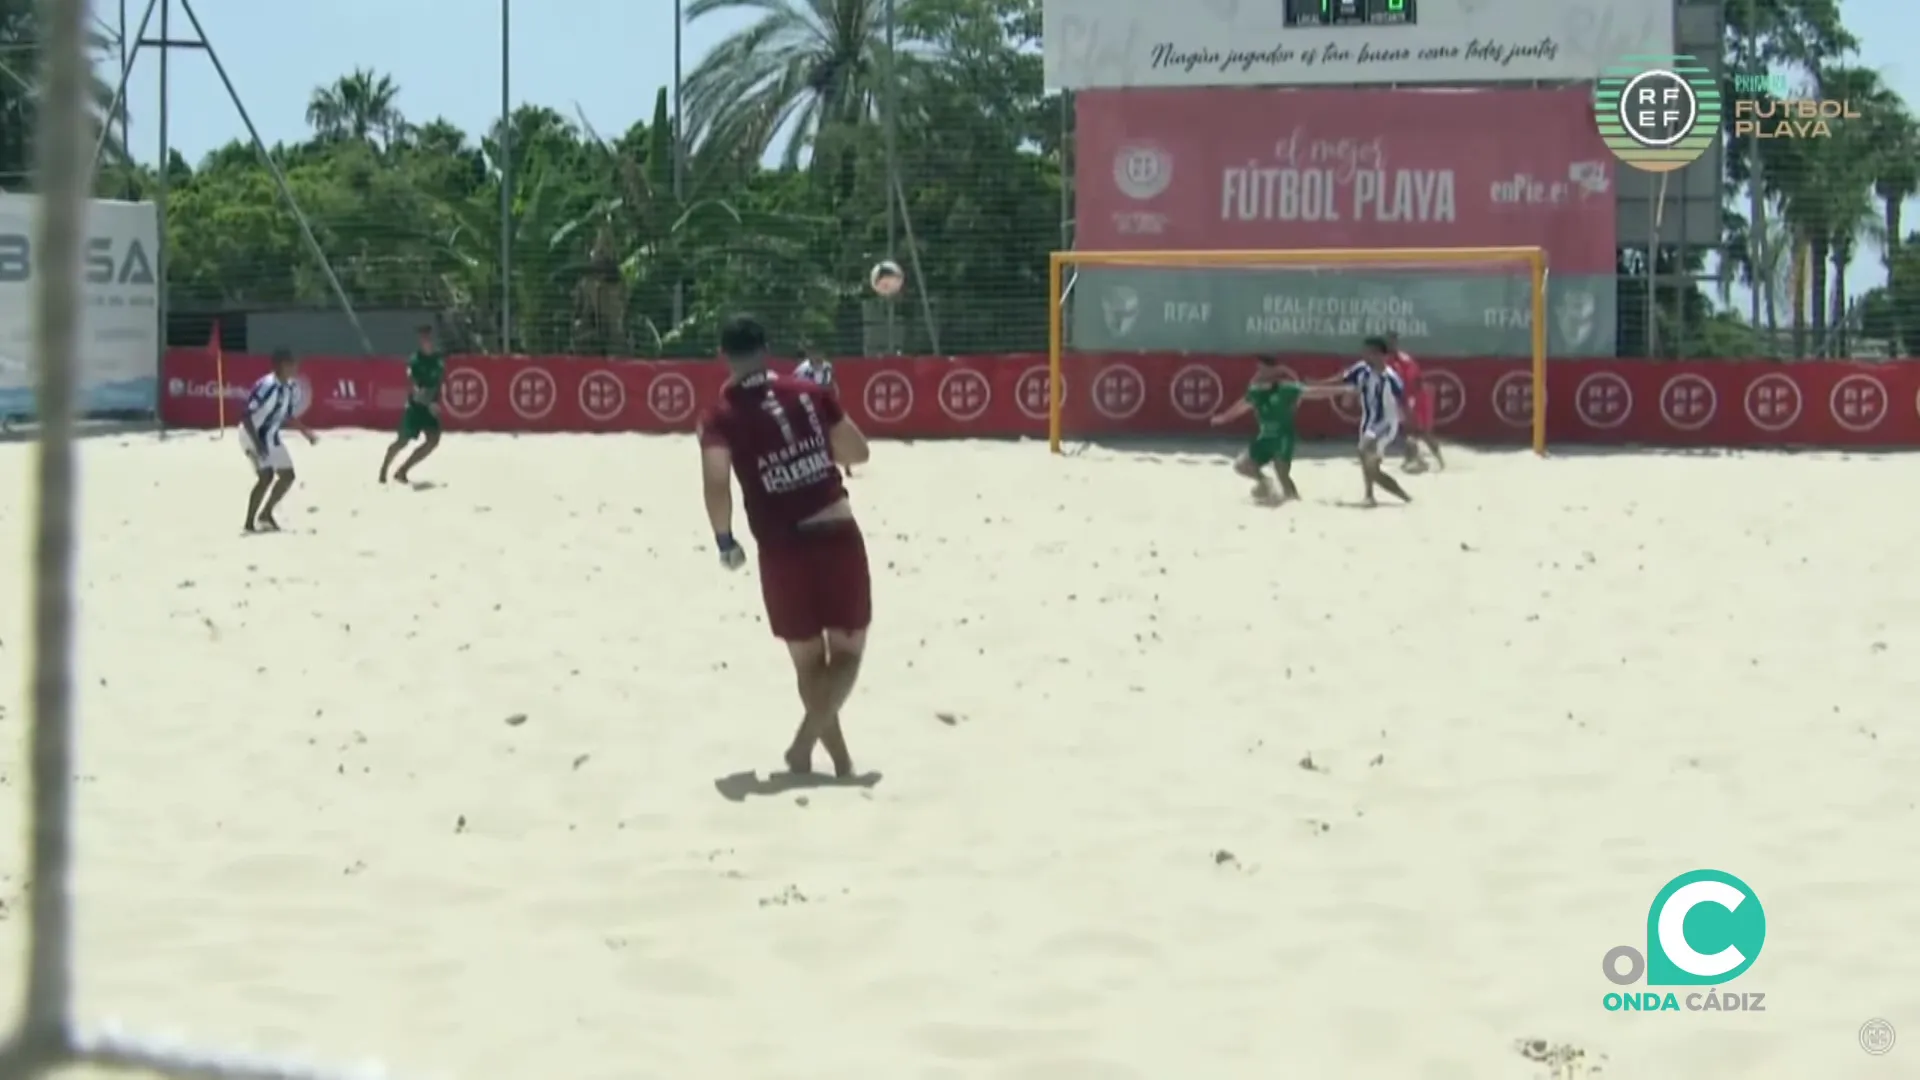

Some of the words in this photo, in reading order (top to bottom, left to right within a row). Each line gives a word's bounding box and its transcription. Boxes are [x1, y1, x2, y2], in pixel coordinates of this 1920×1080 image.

[1220, 43, 1294, 71] jugador
[1301, 48, 1316, 66] es
[1322, 41, 1350, 65] tan
[1357, 42, 1410, 65] bueno
[1417, 46, 1459, 60] como
[1465, 38, 1501, 62] todos
[1501, 37, 1559, 66] juntos
[1222, 158, 1339, 221] FÚTBOL
[1354, 168, 1456, 222] PLAYA
[1263, 293, 1304, 314] REAL
[1339, 316, 1360, 336] DE
